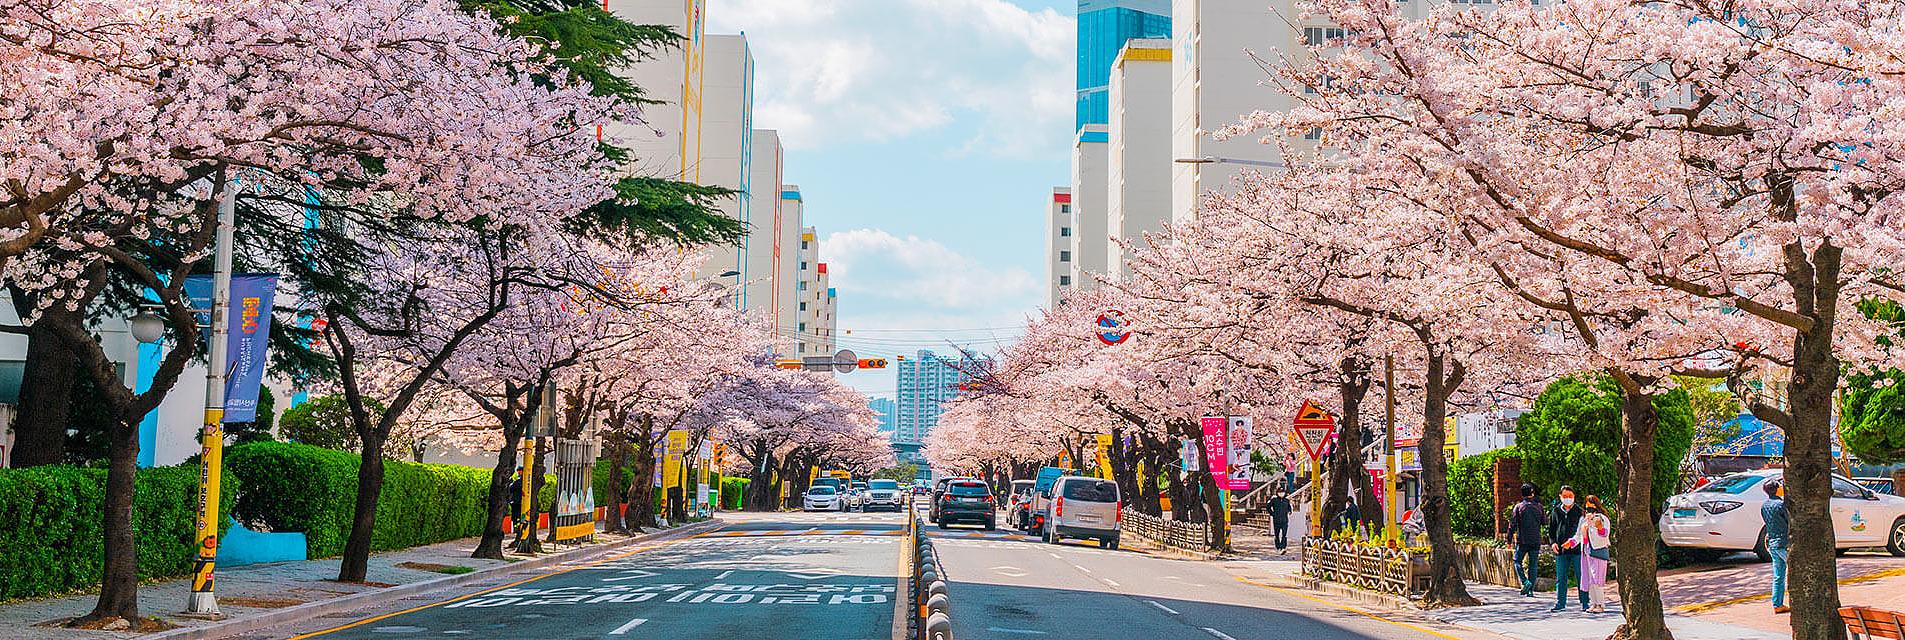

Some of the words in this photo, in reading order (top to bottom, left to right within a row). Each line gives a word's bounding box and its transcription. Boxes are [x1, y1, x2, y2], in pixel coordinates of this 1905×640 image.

[1215, 428, 1224, 456] 소수빈
[445, 593, 658, 609] 어린이
[687, 592, 887, 604] 어린이
